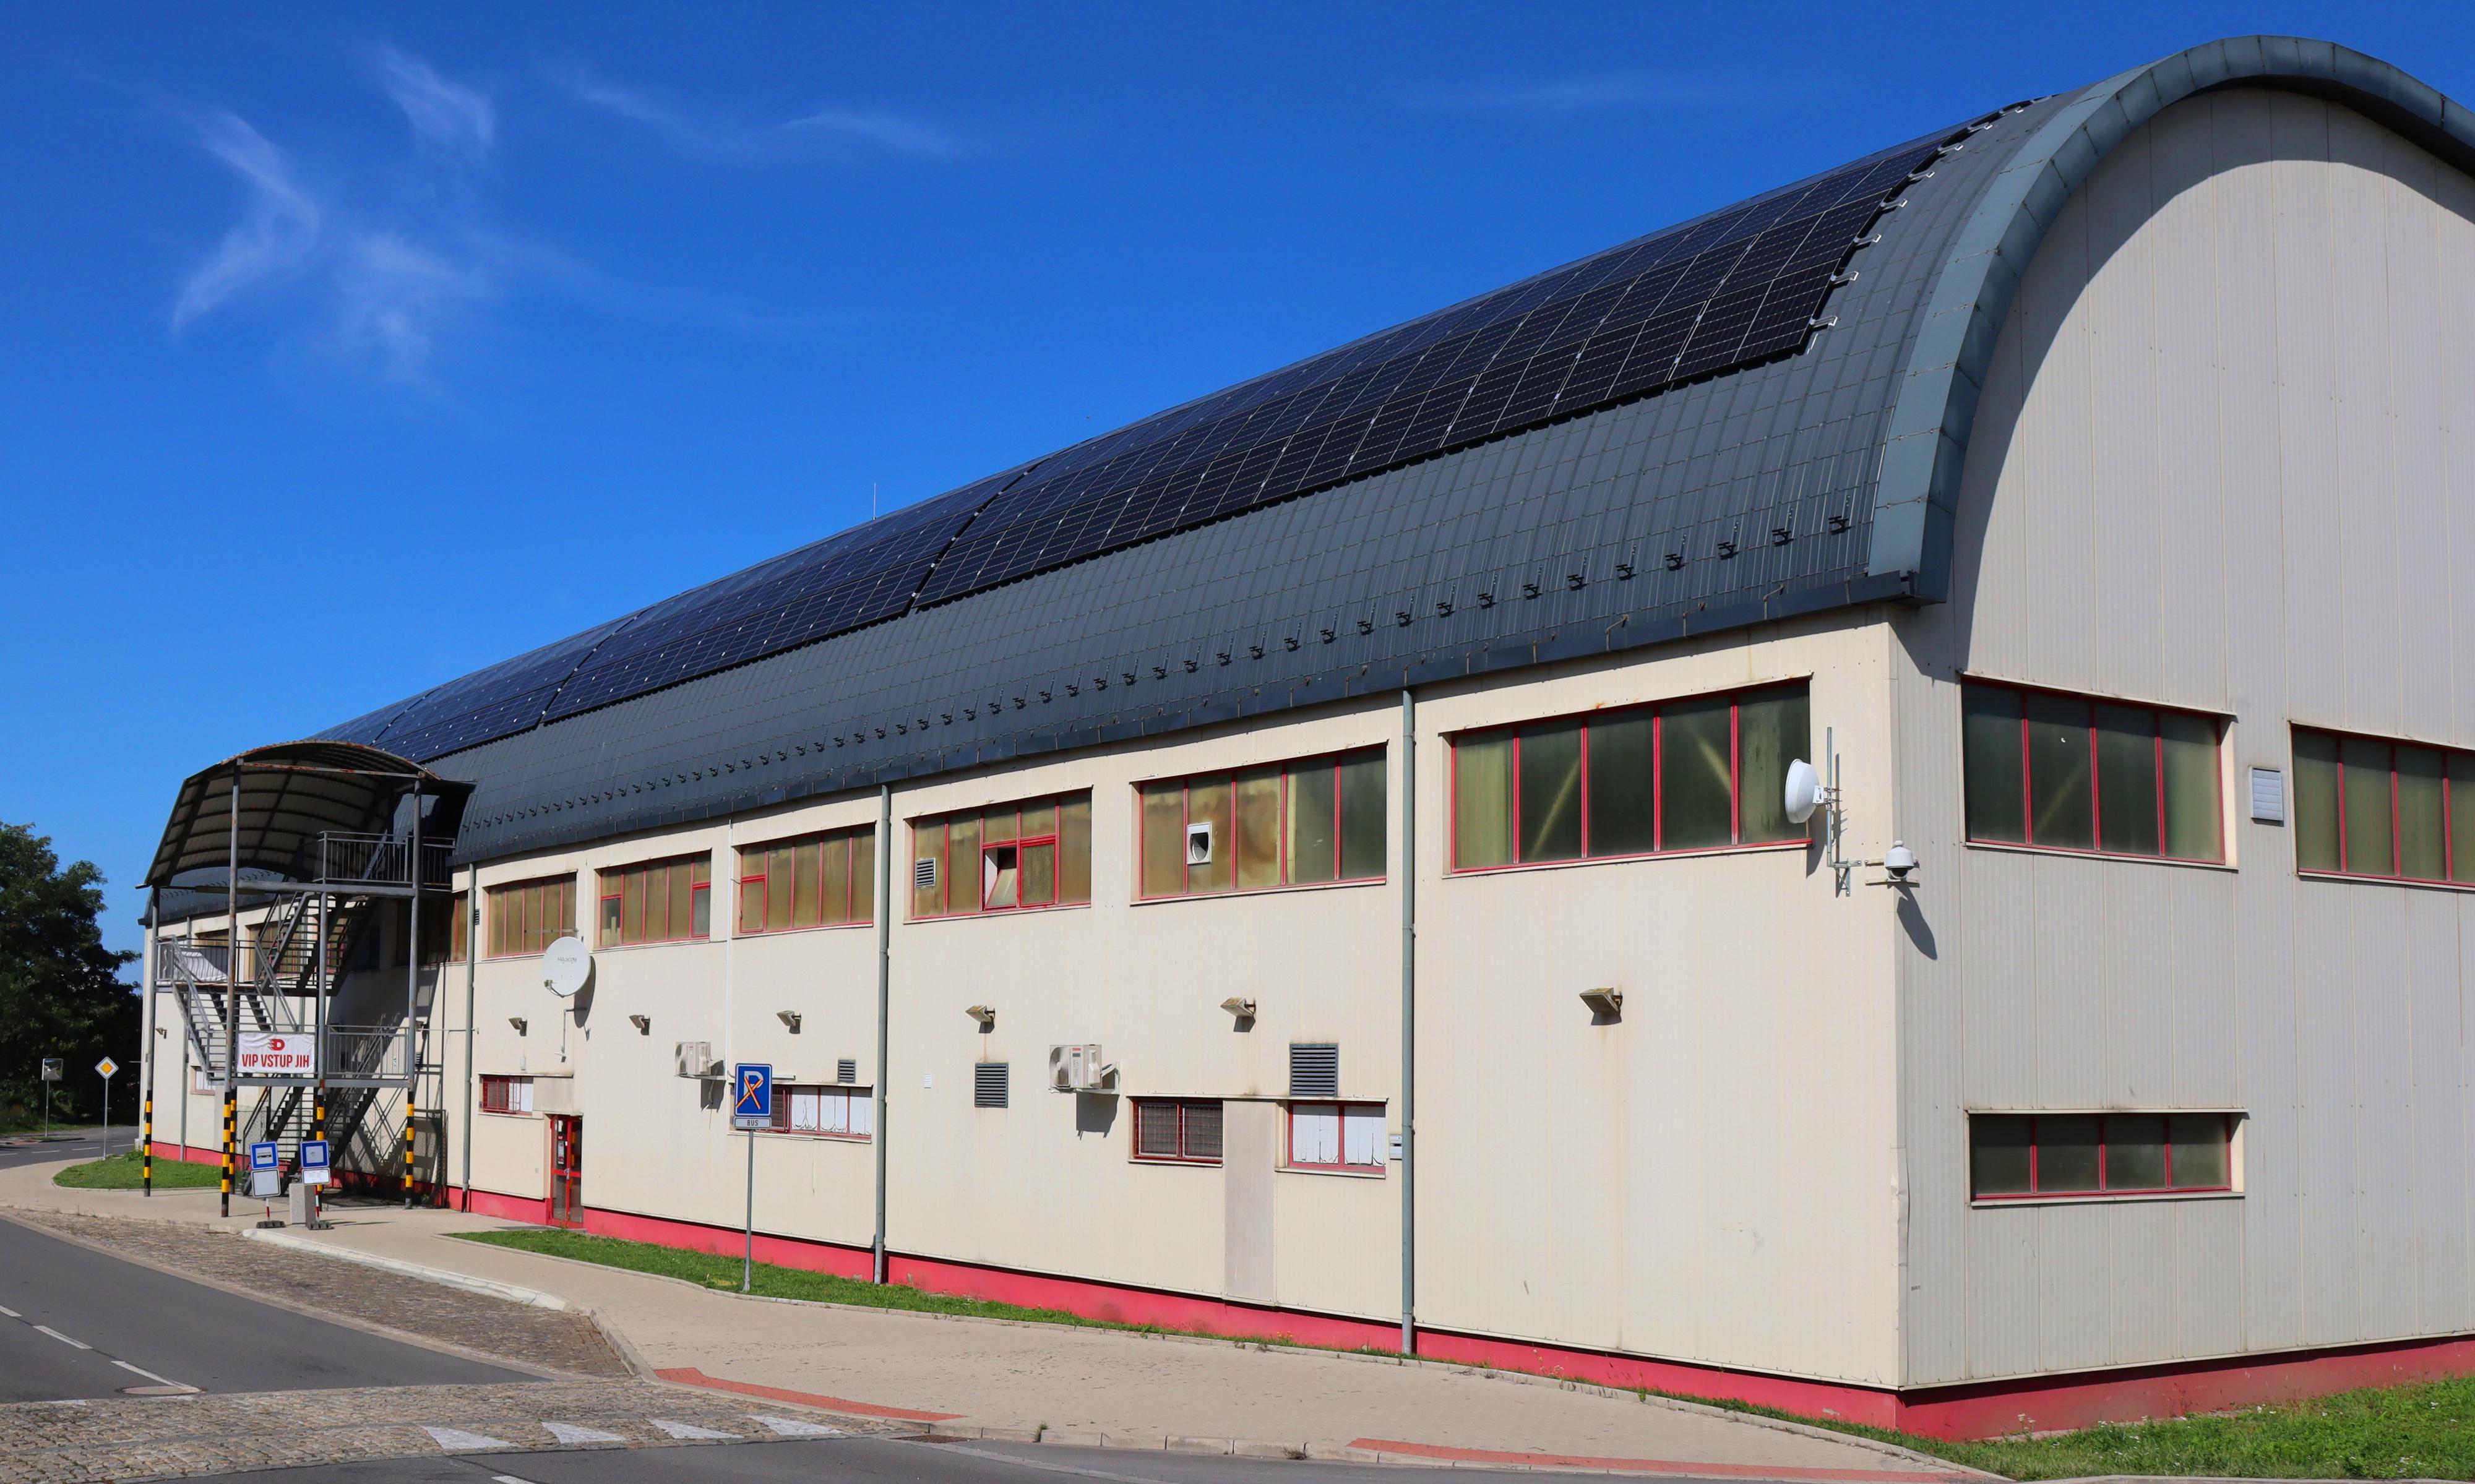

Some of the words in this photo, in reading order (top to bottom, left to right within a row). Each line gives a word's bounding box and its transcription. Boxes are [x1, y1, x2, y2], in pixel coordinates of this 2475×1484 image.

[242, 1053, 259, 1067] VIP
[260, 1053, 293, 1068] VSTUP
[295, 1055, 309, 1068] JIH
